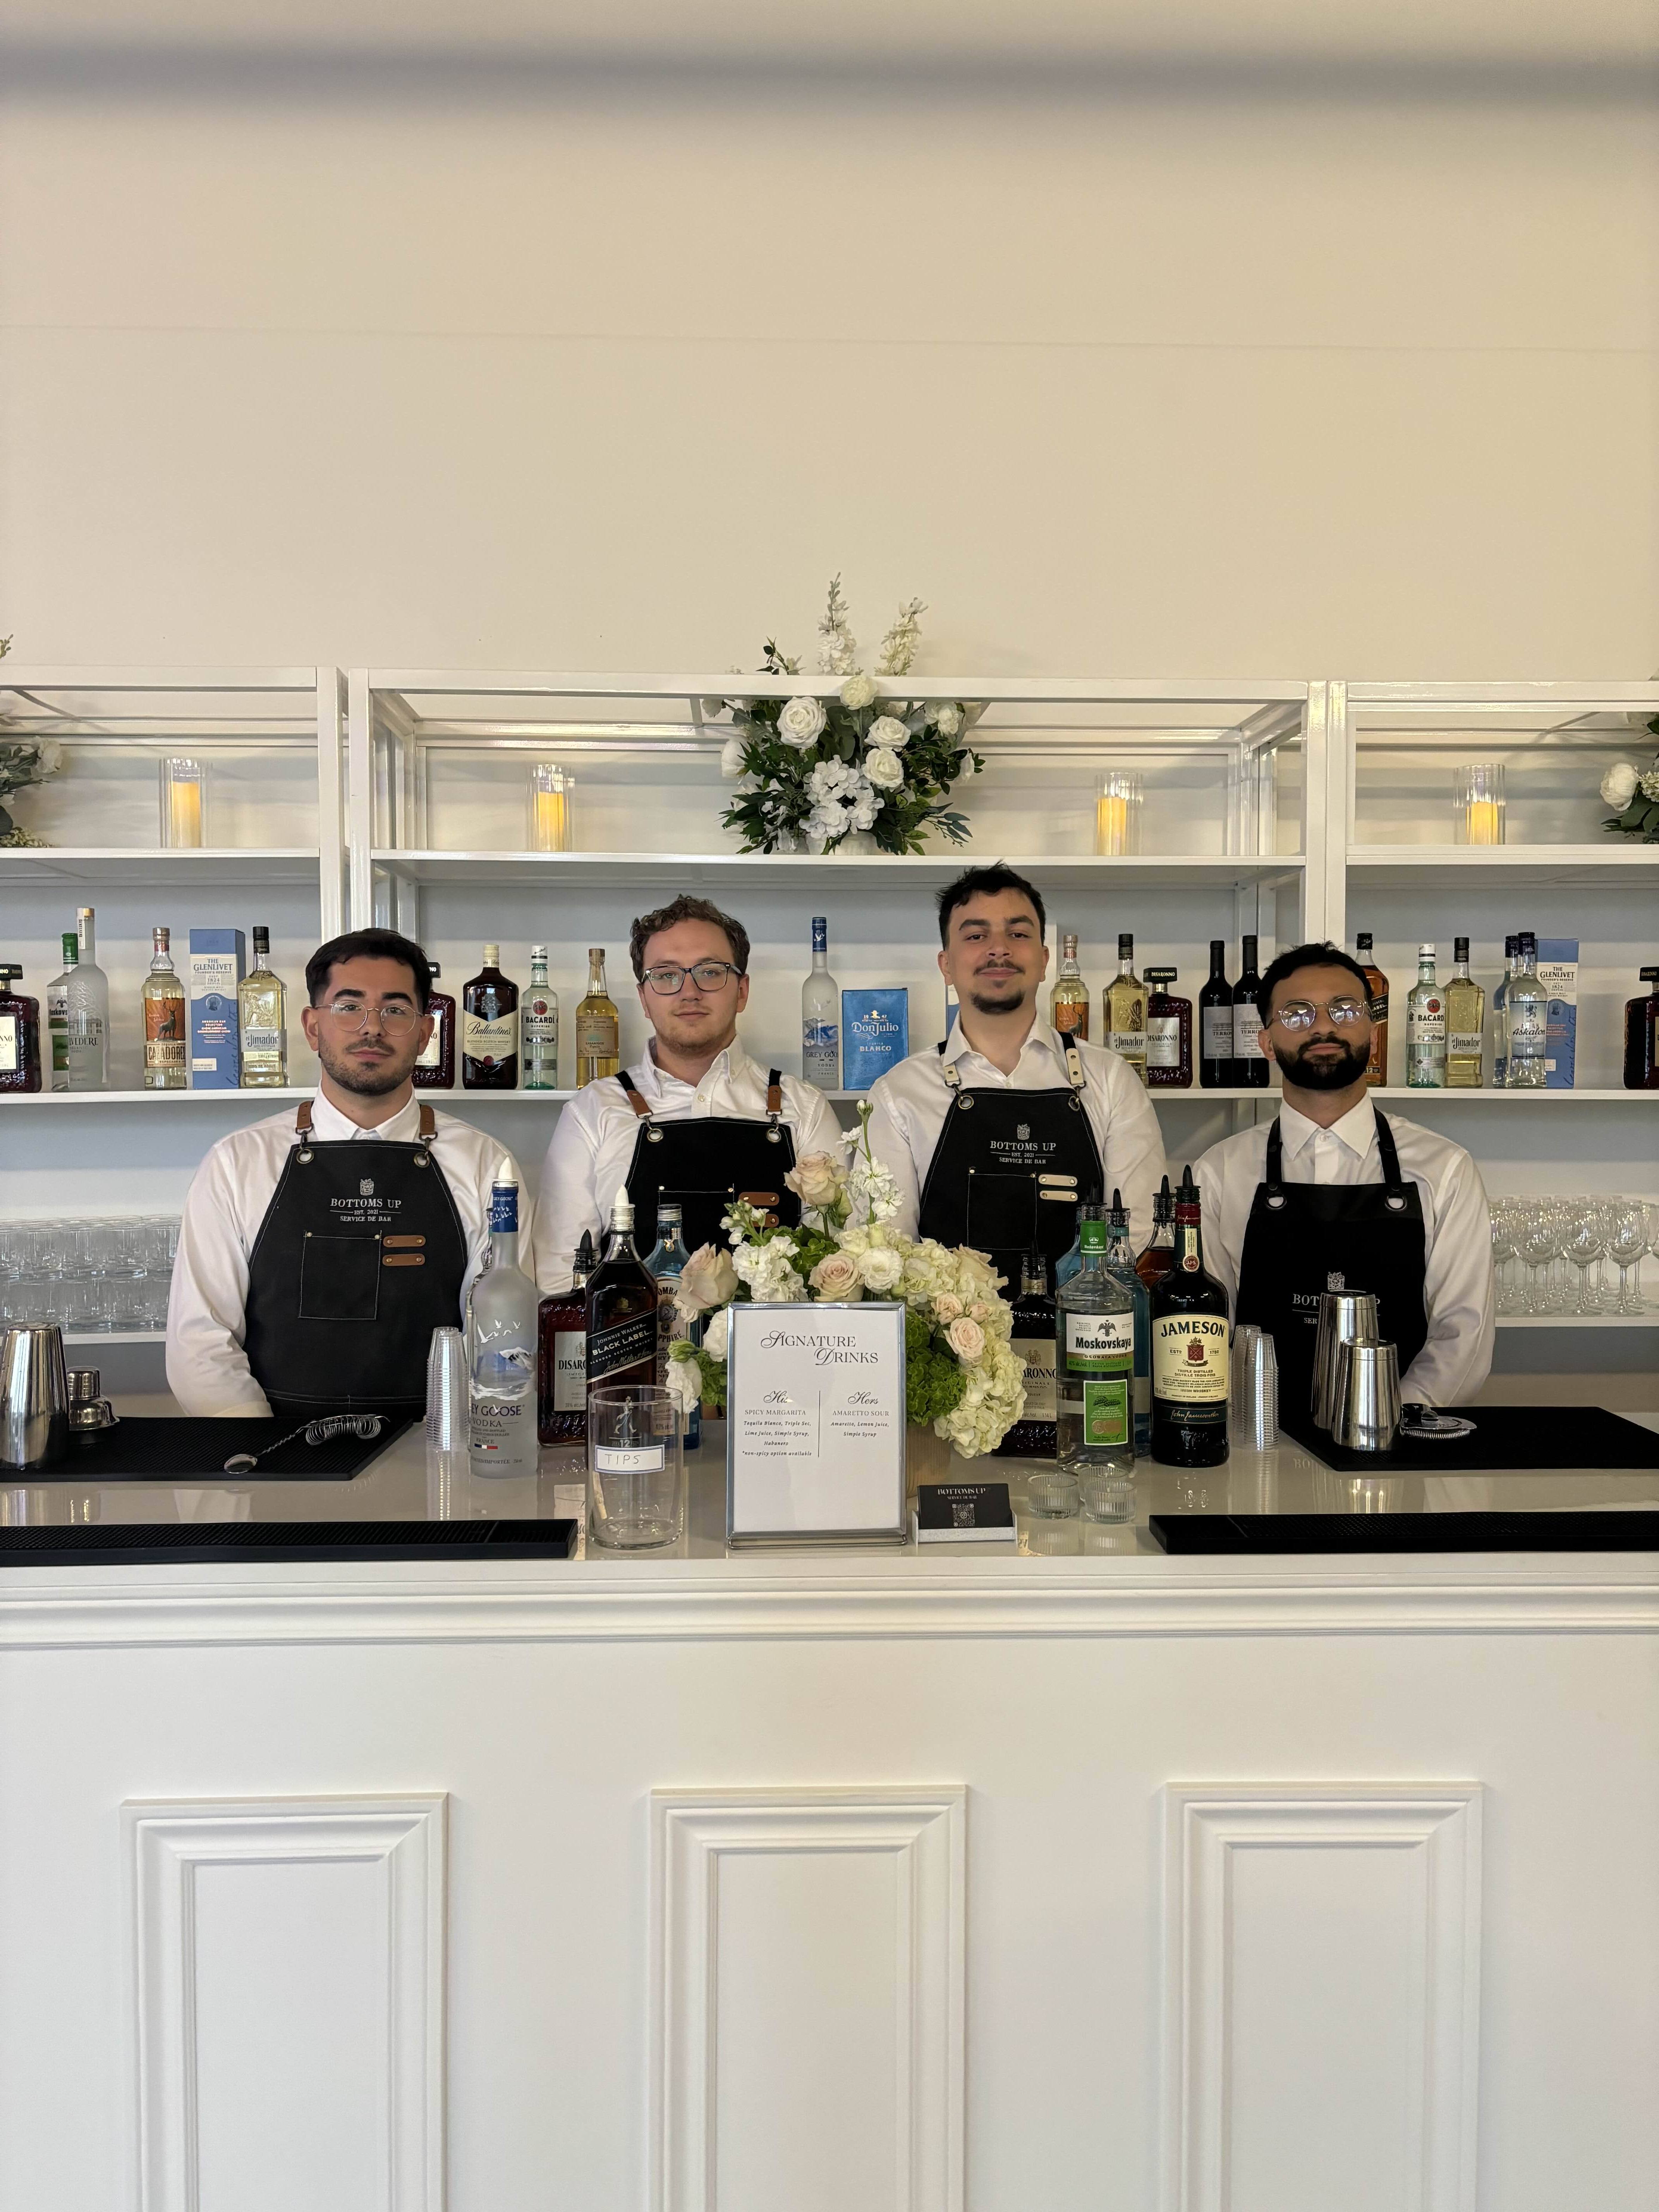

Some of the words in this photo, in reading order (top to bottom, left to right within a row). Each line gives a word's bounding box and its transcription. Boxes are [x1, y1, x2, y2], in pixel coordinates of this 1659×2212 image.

[526, 1015, 555, 1024] BACARDÍ
[466, 1021, 511, 1035] Ballantine's
[852, 1022, 875, 1032] Don
[871, 1022, 898, 1036] Julio
[1513, 1026, 1545, 1036] Askalon
[247, 1034, 279, 1047] Jimador
[1115, 1036, 1144, 1049] Jimador
[1453, 1037, 1480, 1049] Jimador
[149, 1046, 185, 1060] CAZADORES
[990, 1141, 1038, 1151] BOTTOMS
[330, 1198, 383, 1207] BOTTOMS
[387, 1199, 402, 1208] UP
[658, 1286, 678, 1296] OMBA
[597, 1333, 621, 1346] JOHNNIE
[621, 1324, 644, 1335] WALKER
[1161, 1321, 1224, 1338] JAMESON
[592, 1341, 620, 1355] BLACK
[622, 1330, 650, 1344] LABEL
[658, 1331, 682, 1342] PPHIRE
[761, 1331, 856, 1348] SIGNATURE
[1075, 1336, 1132, 1351] Moskovskaya
[590, 1355, 611, 1364] BLENDED
[614, 1346, 632, 1355] SCOTCH
[814, 1347, 878, 1365] DRINKS
[558, 1360, 586, 1370] DISAR
[1023, 1368, 1056, 1379] ARONNO
[848, 1392, 879, 1404] Hers
[481, 1405, 522, 1416] GOOSE
[473, 1417, 502, 1427] VODKA
[620, 1439, 630, 1448] 12
[605, 1454, 641, 1465] TIPS
